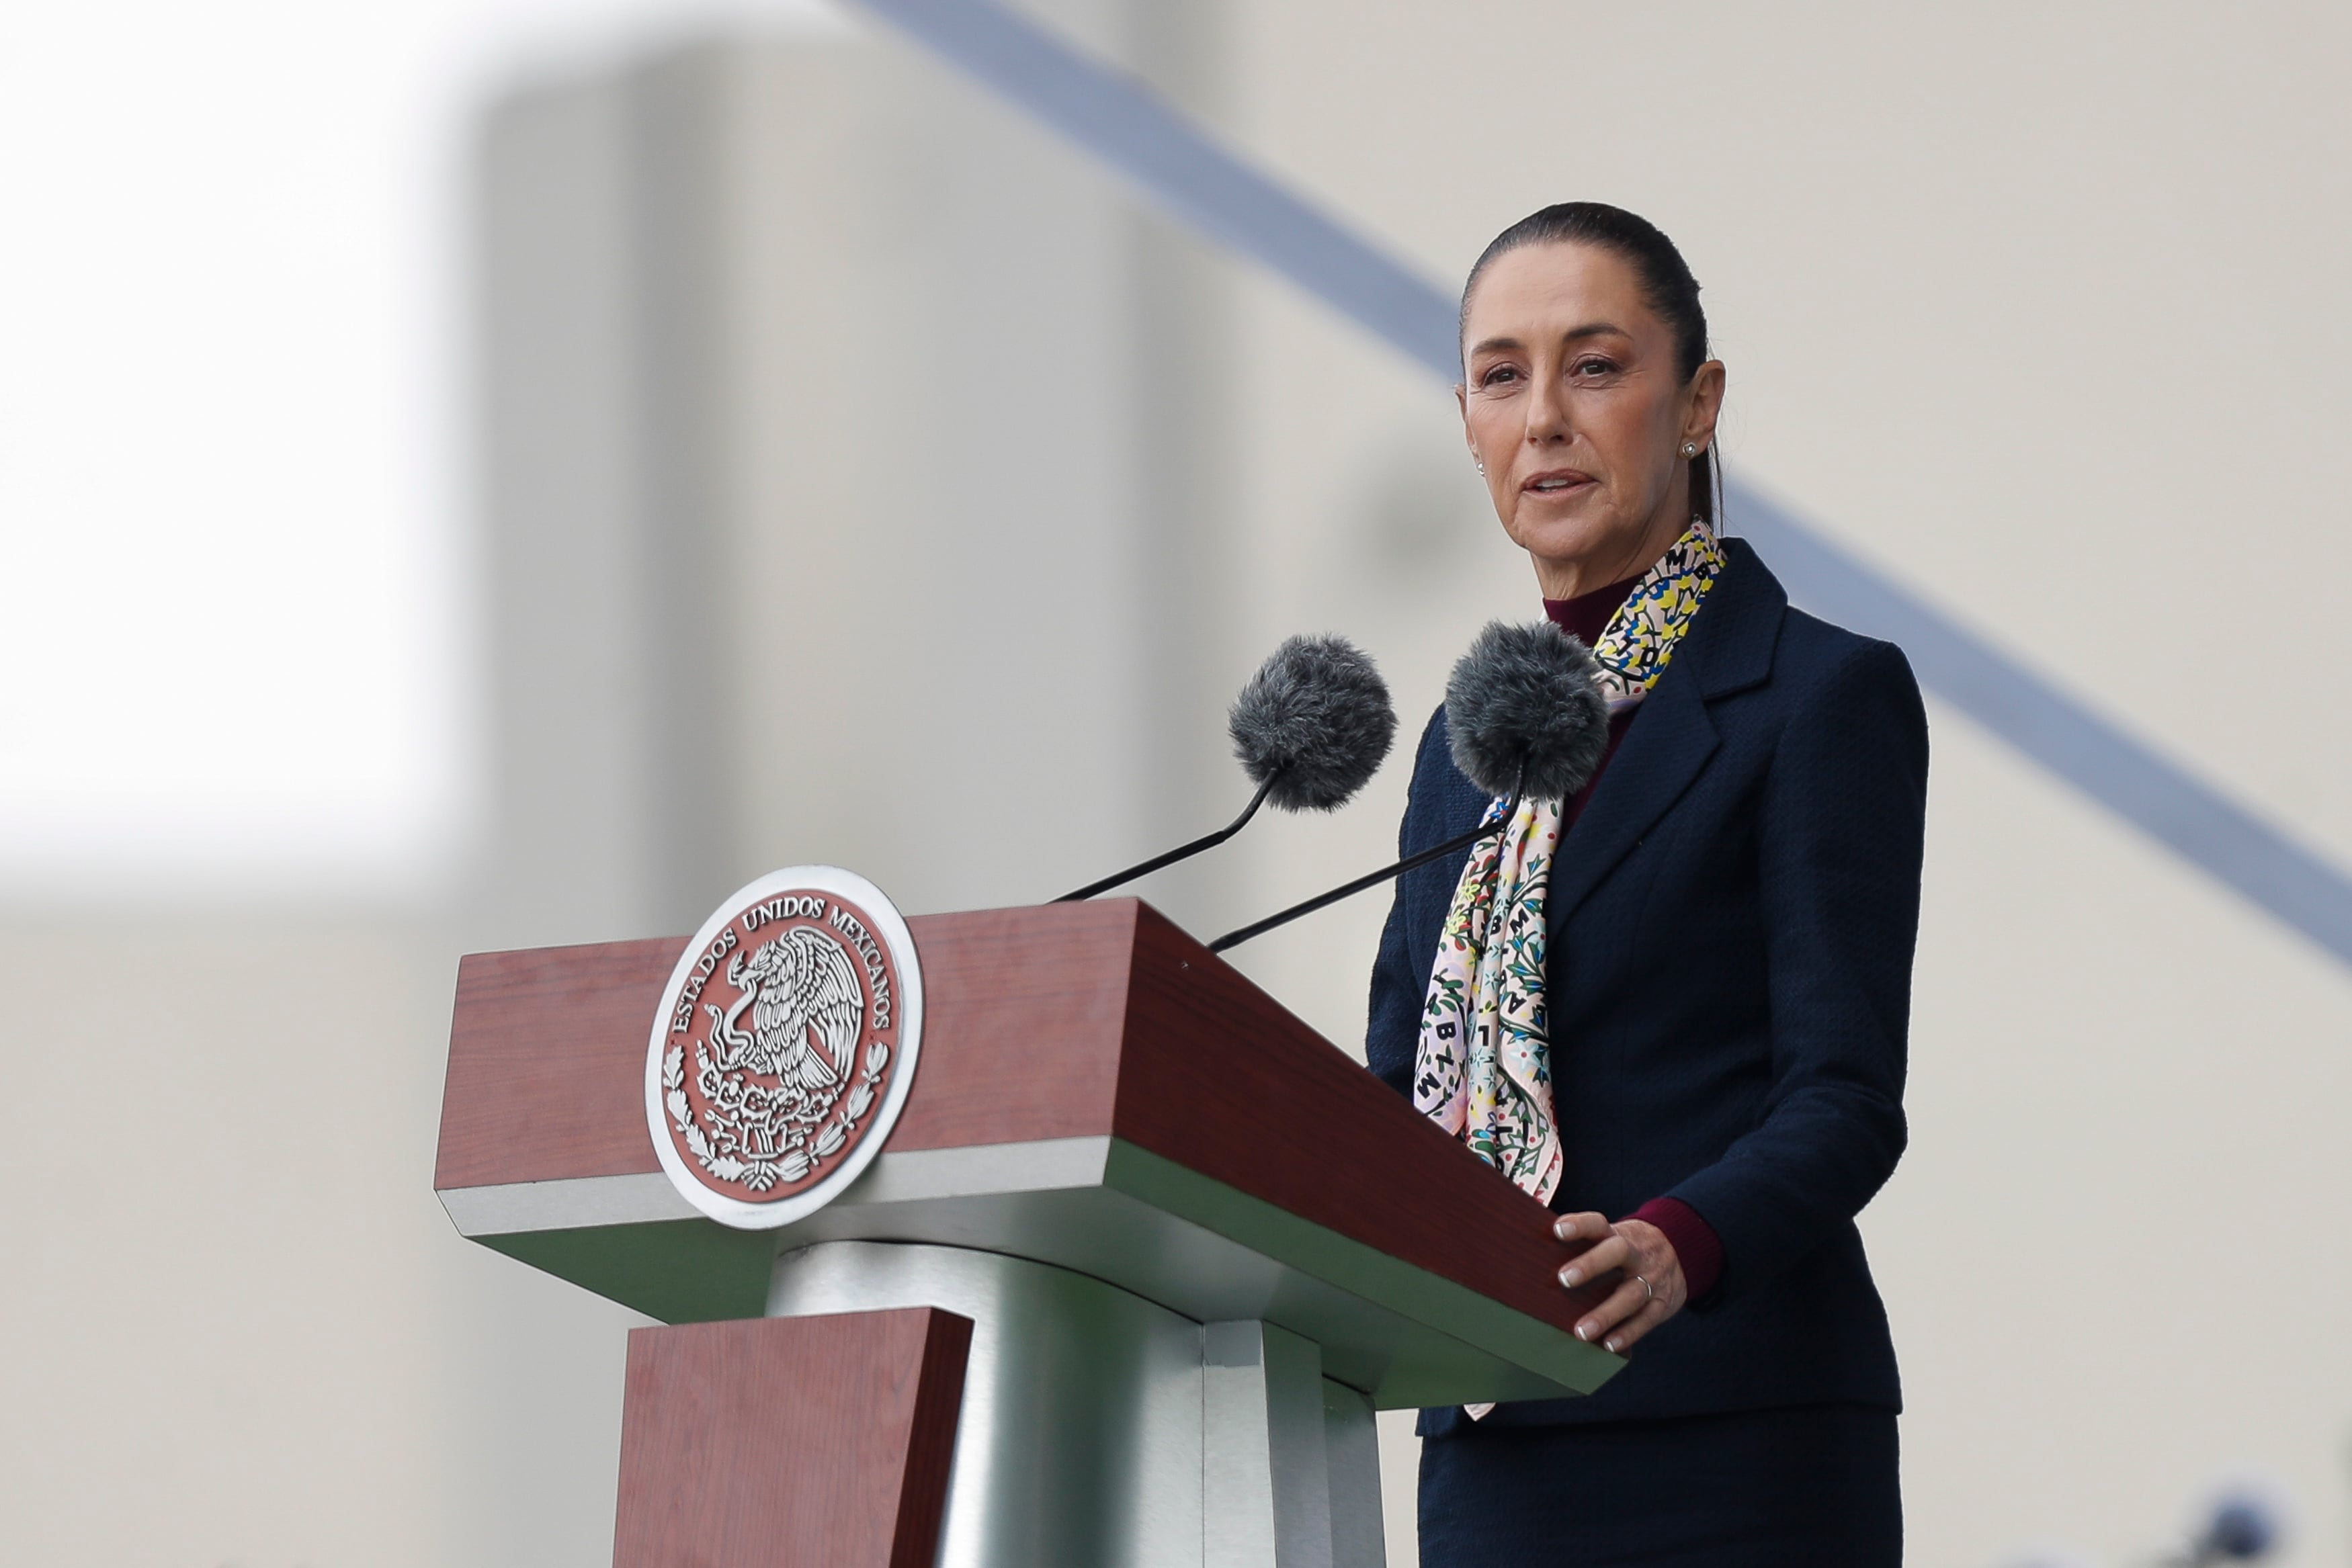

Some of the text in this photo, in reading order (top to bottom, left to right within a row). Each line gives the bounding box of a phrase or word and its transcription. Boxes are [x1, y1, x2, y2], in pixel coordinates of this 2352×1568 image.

[672, 896, 892, 1035] ESTADOS UNIDOS MEXICANOS
